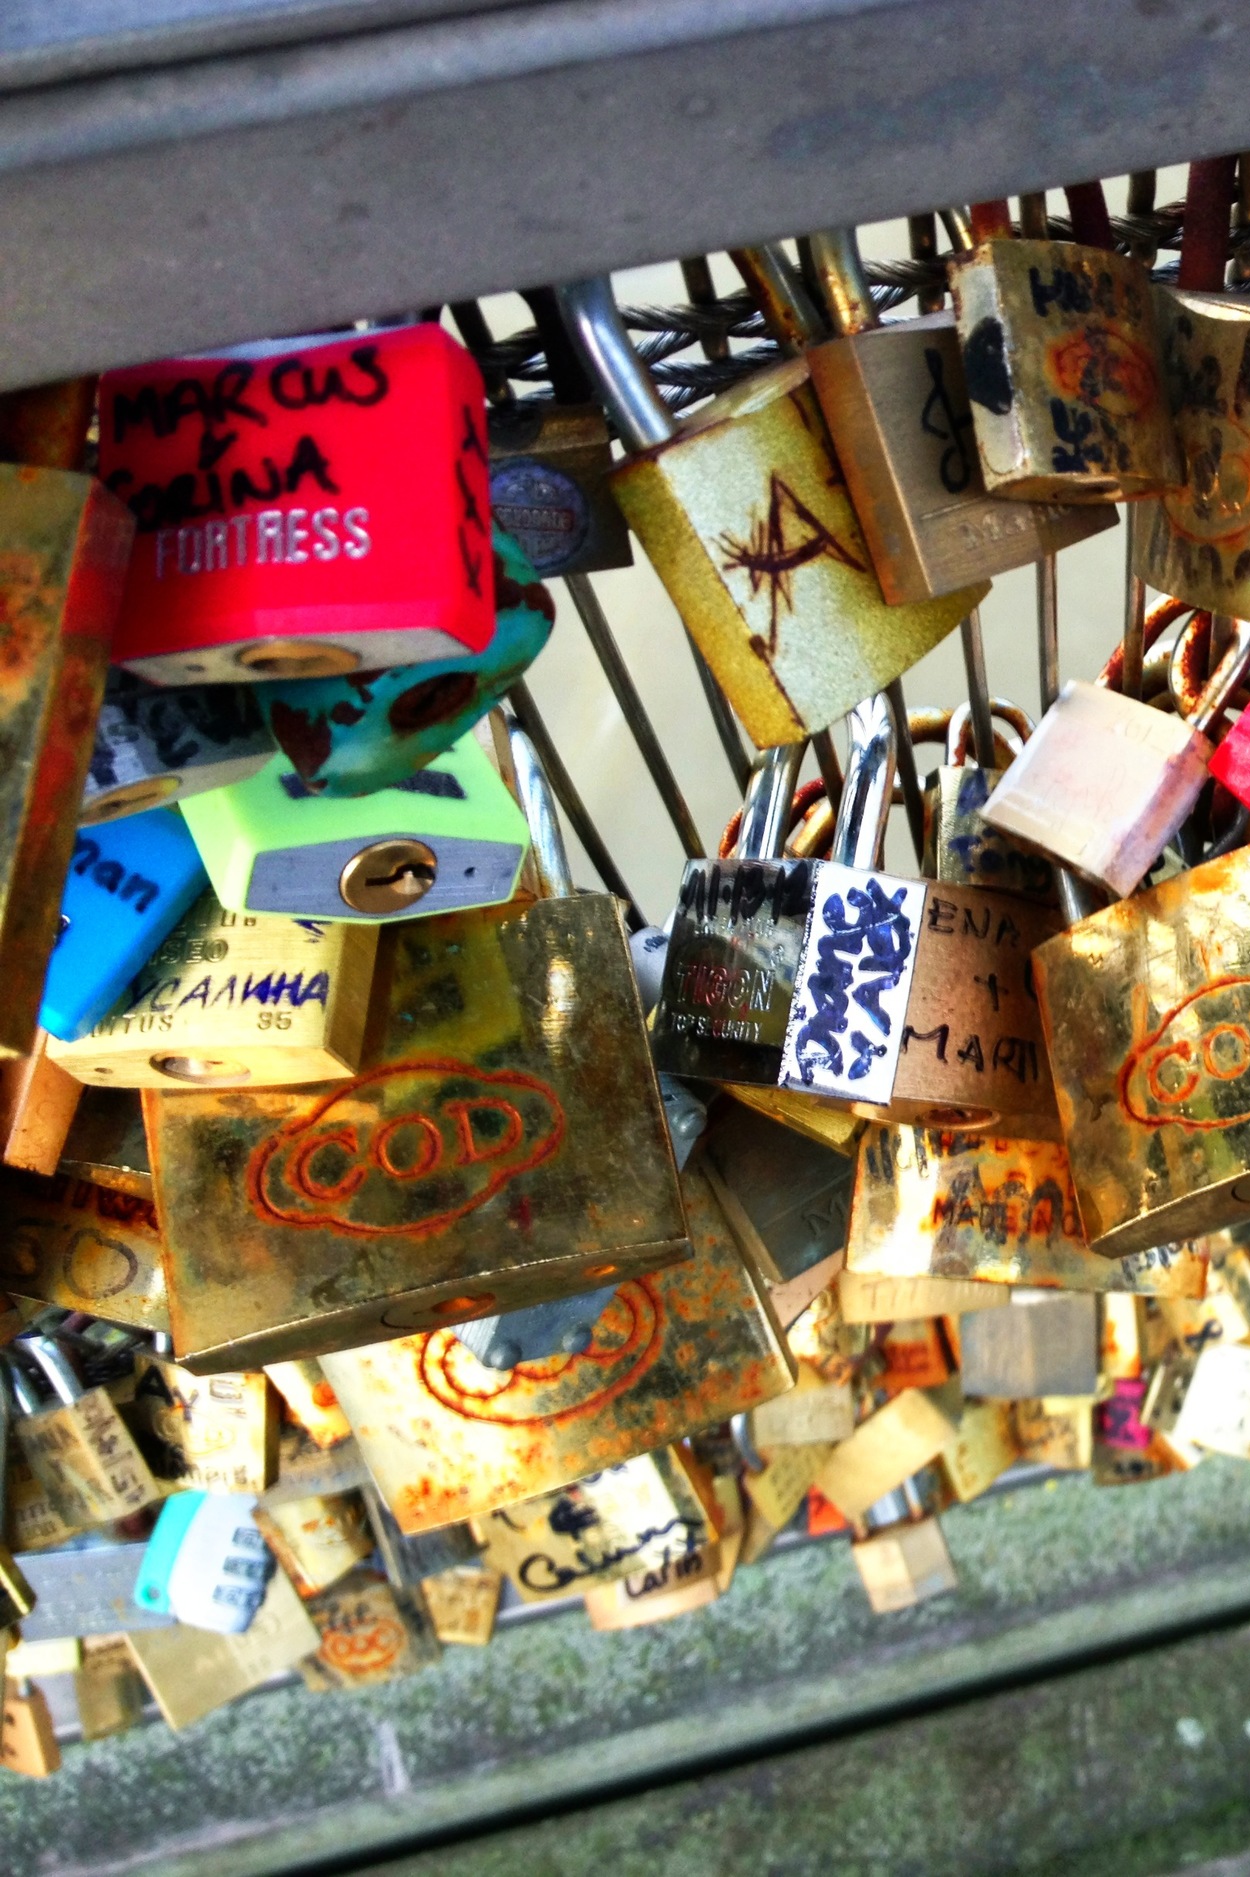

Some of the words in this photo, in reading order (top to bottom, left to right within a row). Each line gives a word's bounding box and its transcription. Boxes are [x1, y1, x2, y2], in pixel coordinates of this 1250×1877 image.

[112, 346, 390, 443] MARCUS
[154, 506, 372, 580] FORTRESS
[284, 1095, 522, 1206] COD
